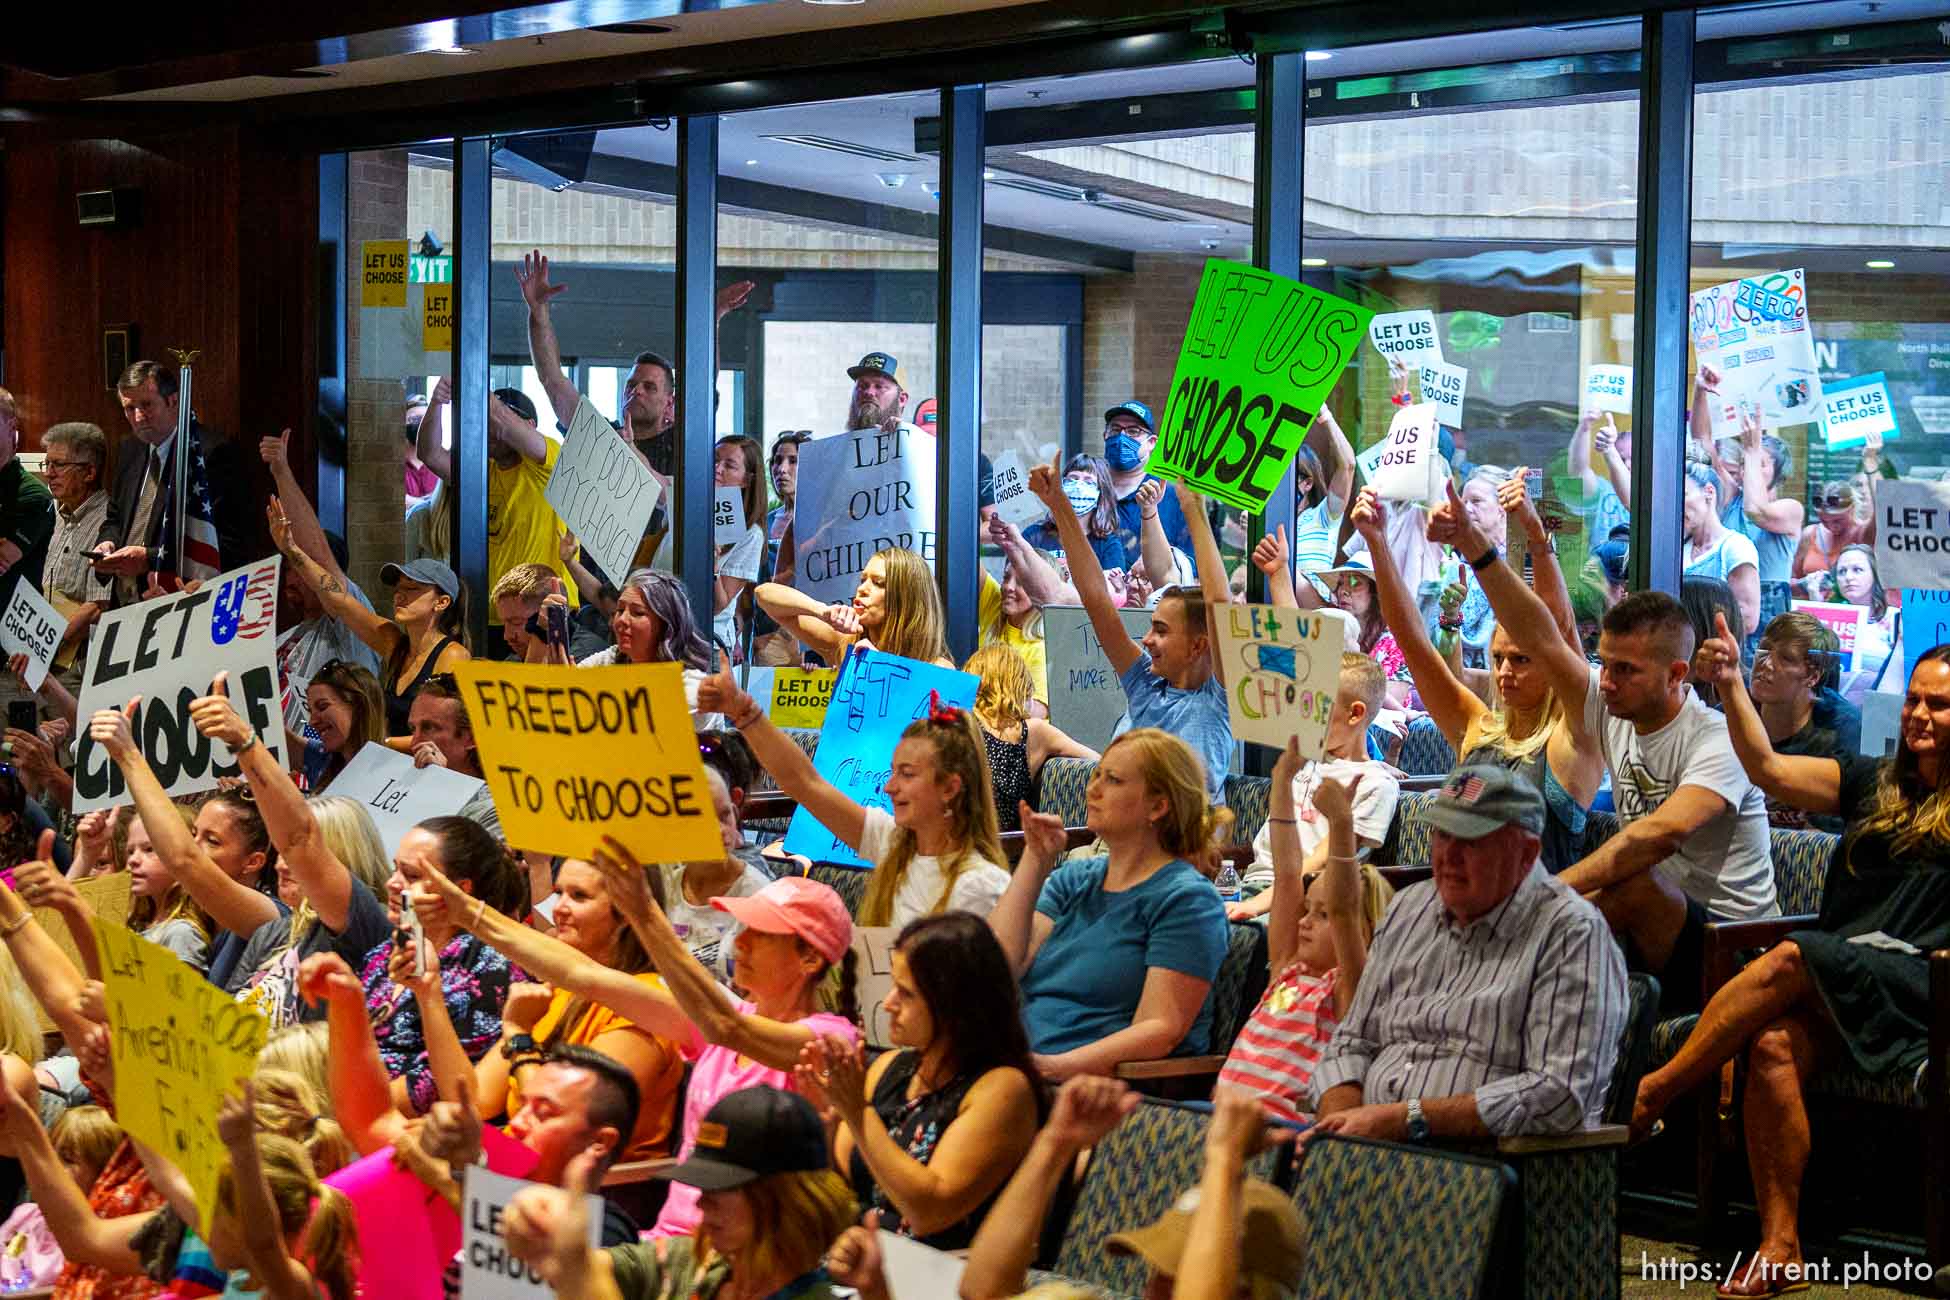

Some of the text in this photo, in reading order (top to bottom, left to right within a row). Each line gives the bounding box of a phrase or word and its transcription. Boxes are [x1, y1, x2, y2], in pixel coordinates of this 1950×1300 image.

[366, 254, 404, 268] LET US
[366, 272, 404, 284] CHOOSE
[427, 297, 448, 311] LET
[1739, 285, 1796, 317] ZERO
[427, 315, 453, 328] CHOO
[1187, 269, 1358, 388] LET US
[1375, 321, 1432, 339] LET US
[1378, 337, 1434, 353] CHOOSE
[1441, 373, 1461, 392] US
[1609, 376, 1625, 385] US
[1826, 391, 1882, 414] LET US
[1830, 404, 1885, 425] CHOOSE
[1163, 376, 1313, 501] CHOOSE
[1395, 426, 1419, 445] US
[567, 402, 651, 516] MY BODY
[852, 429, 910, 469] LET
[995, 467, 1018, 489] LET US
[849, 480, 915, 521] OUR
[996, 483, 1024, 504] CHOOSE
[550, 452, 638, 581] MY CHOICE!
[1886, 506, 1938, 529] LET
[12, 593, 57, 645] LET US
[92, 564, 275, 687] LET US
[5, 612, 49, 665] CHOOSE
[778, 679, 812, 693] LET
[1069, 667, 1108, 692] MORE
[776, 695, 830, 708] CHOOS
[1237, 675, 1333, 725] CHOOSE
[474, 680, 660, 747] FREEDOM
[498, 765, 701, 823] TO CHOOSE
[472, 1197, 505, 1236] LE
[470, 1241, 543, 1285] CHOO
